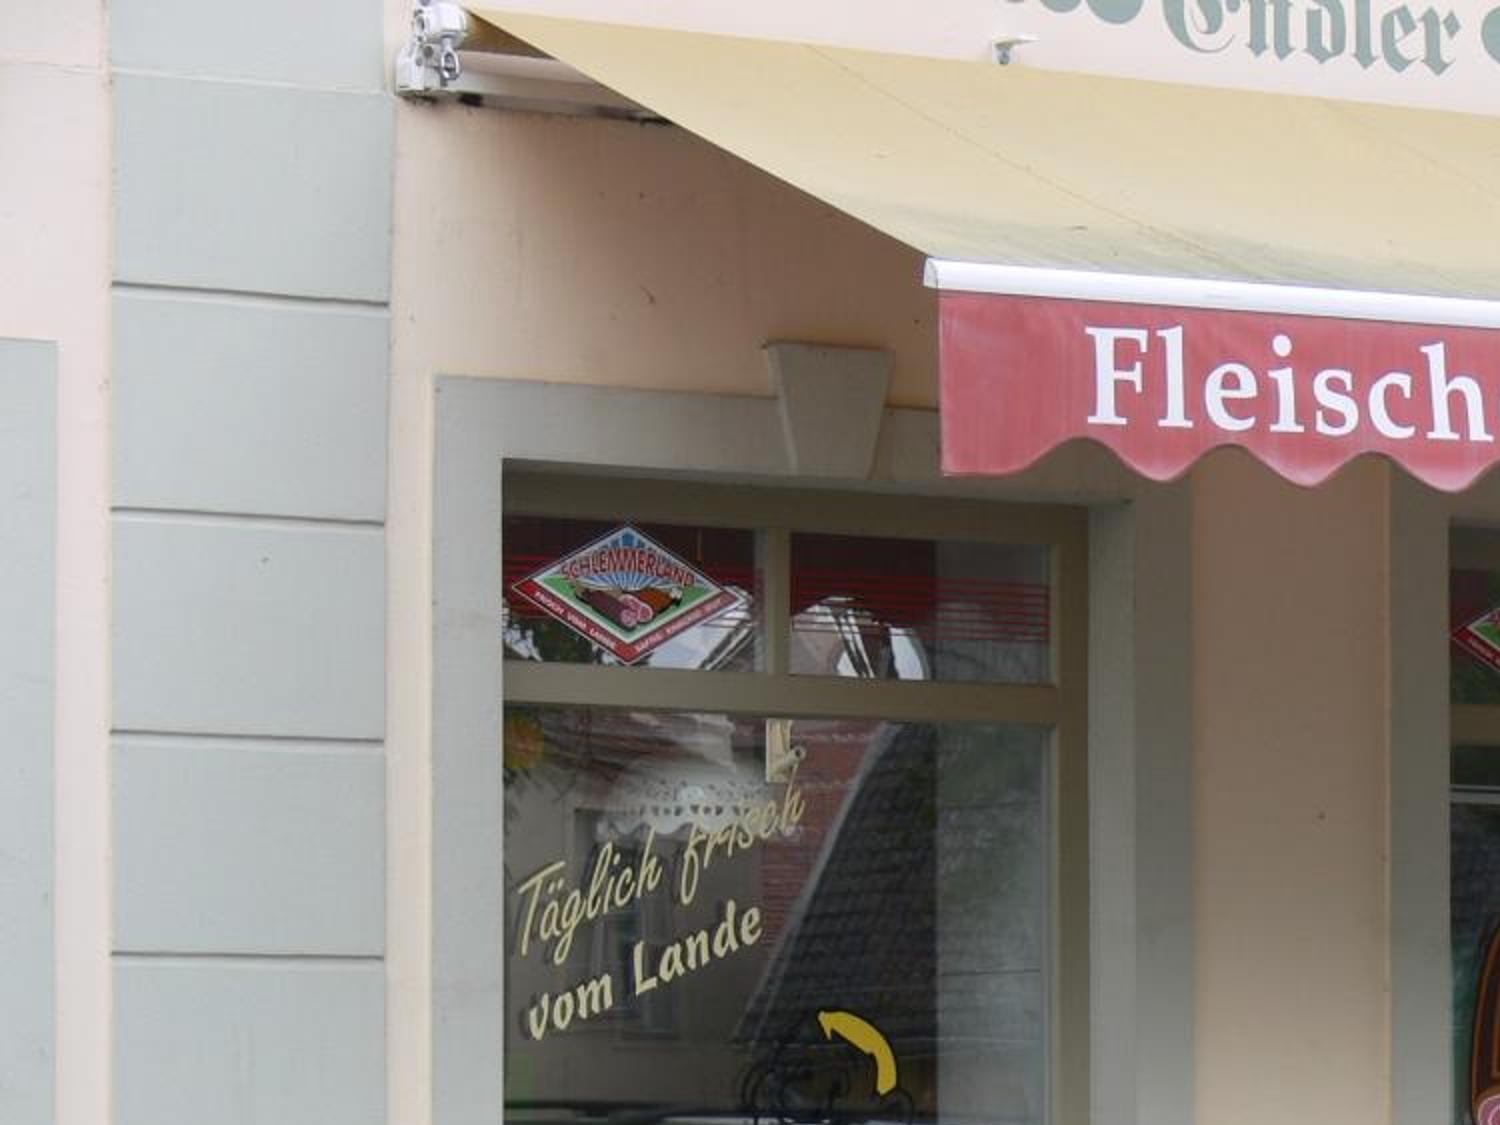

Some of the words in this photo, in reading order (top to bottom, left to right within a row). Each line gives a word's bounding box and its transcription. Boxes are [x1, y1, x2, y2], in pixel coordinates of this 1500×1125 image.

[518, 826, 663, 965] Täglich
[528, 973, 613, 1040] vom
[633, 899, 763, 995] Lande
